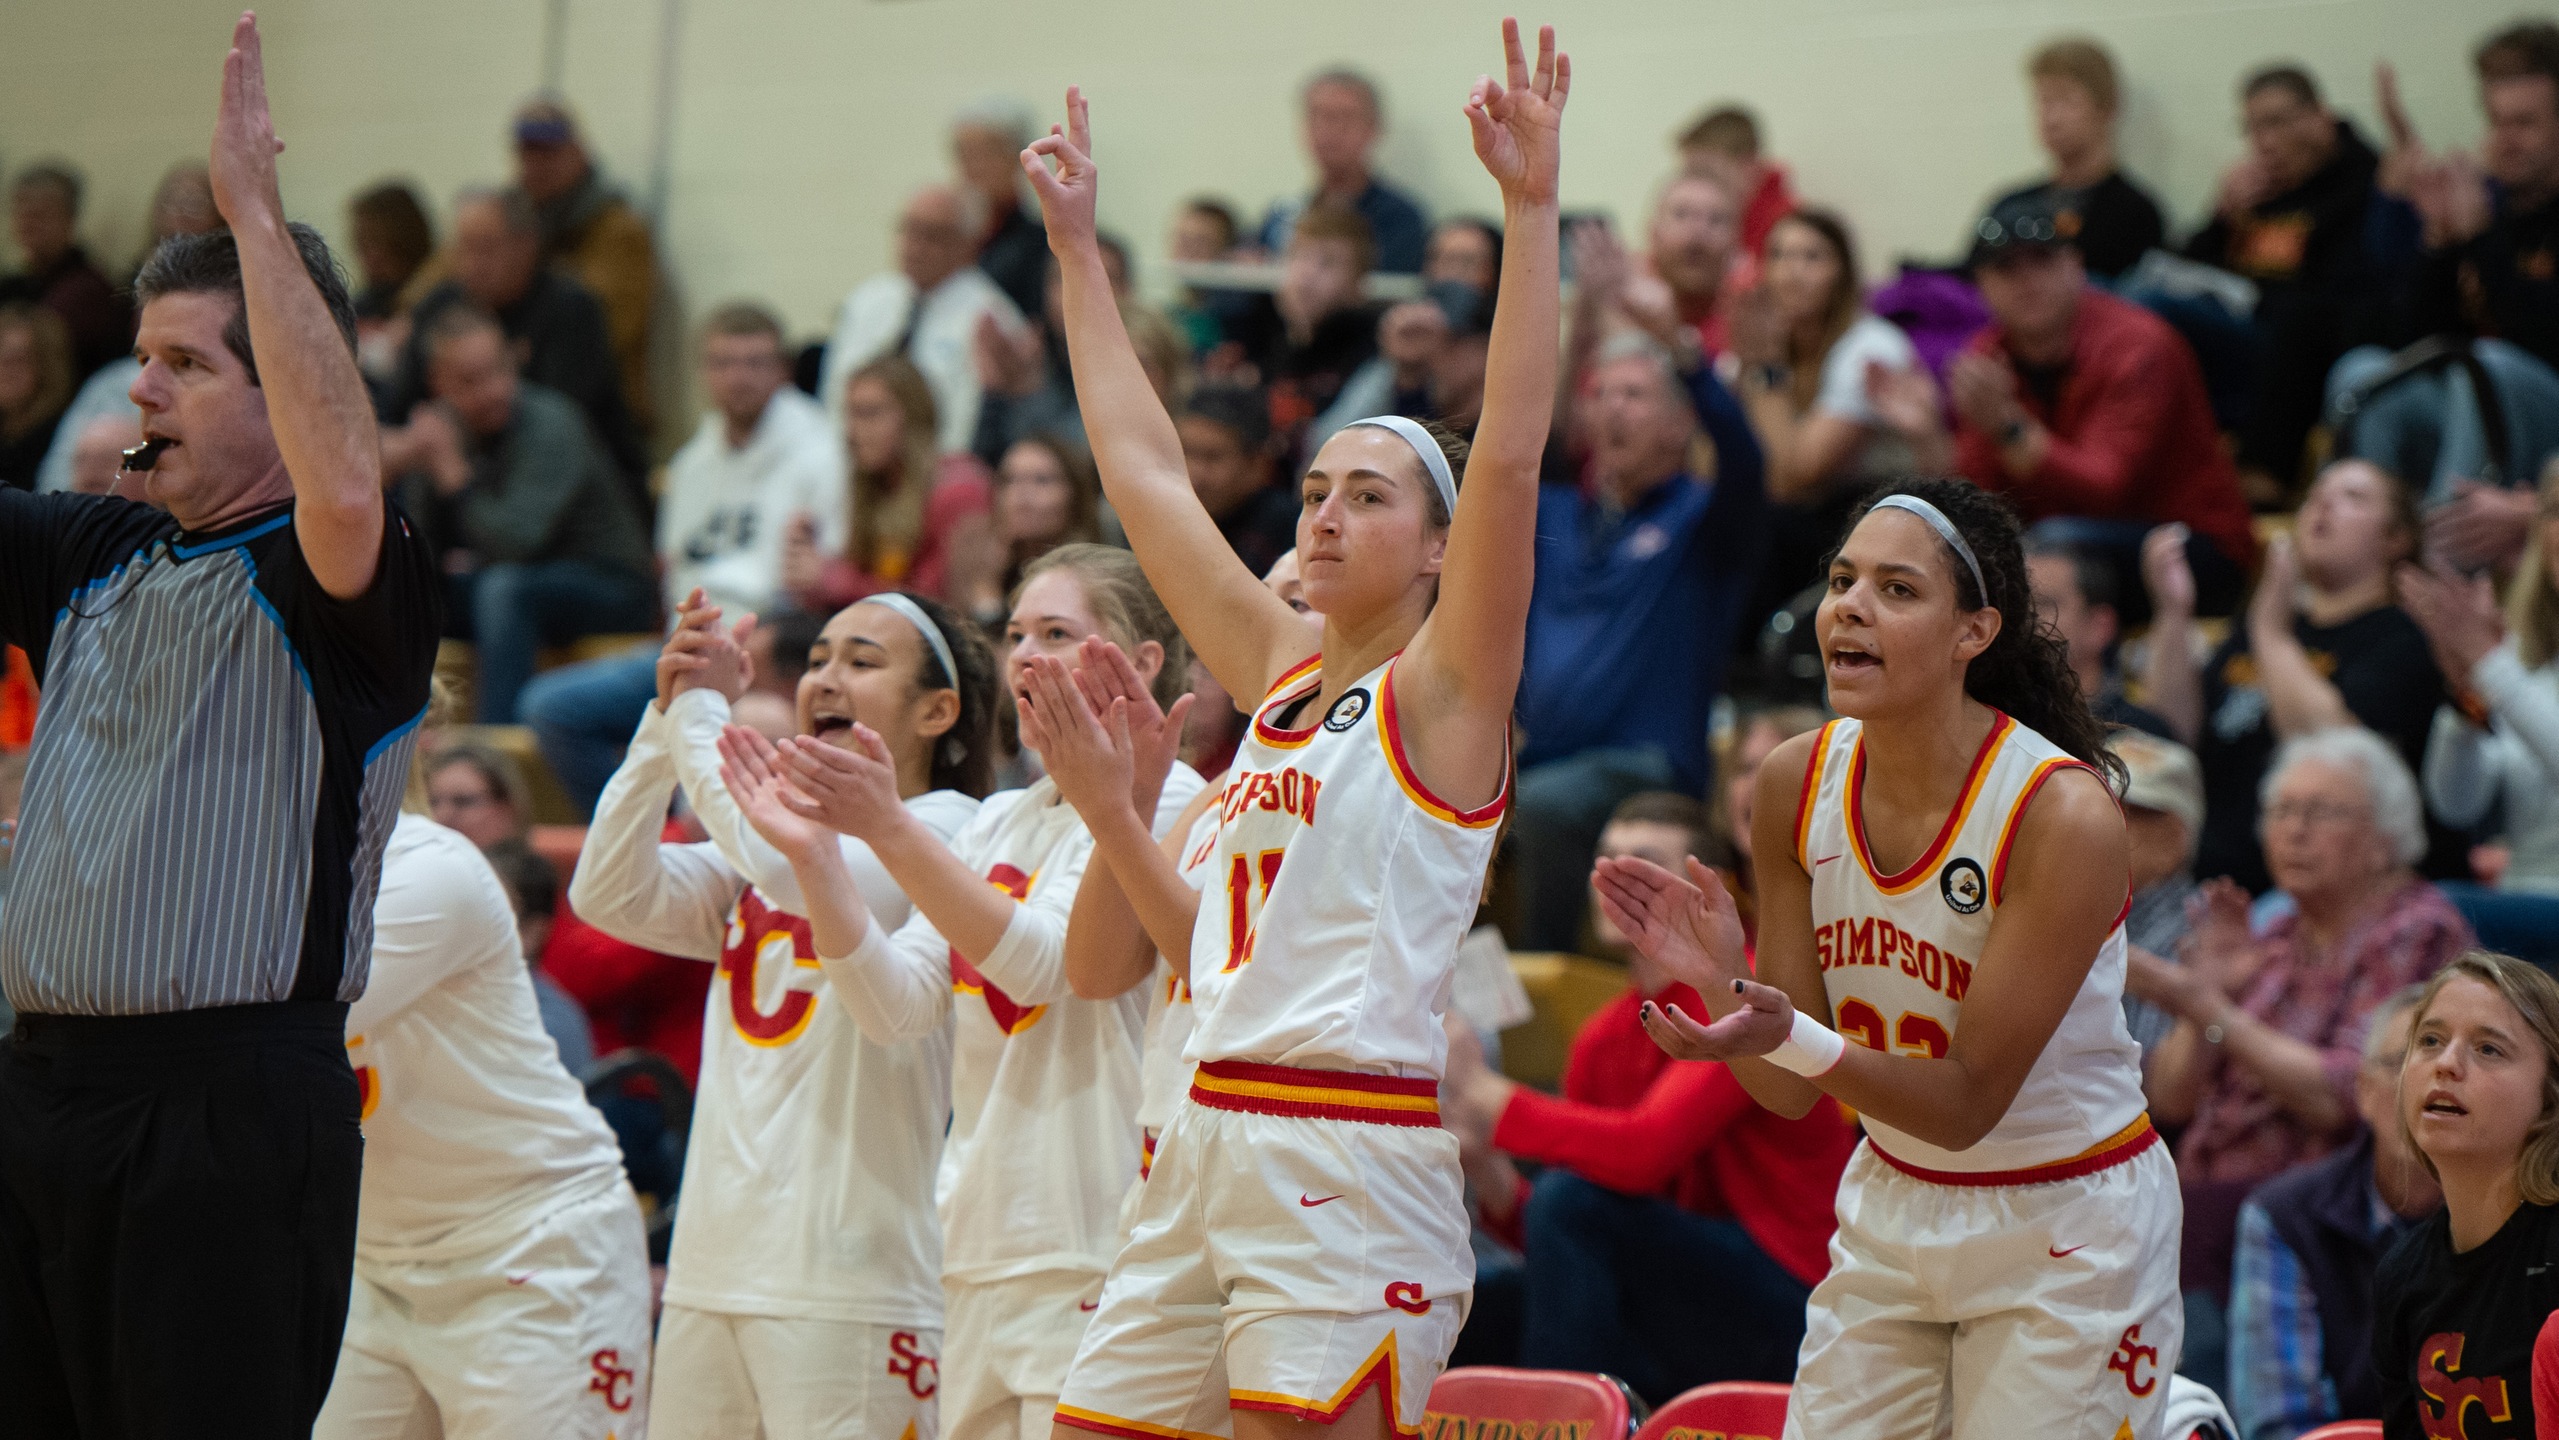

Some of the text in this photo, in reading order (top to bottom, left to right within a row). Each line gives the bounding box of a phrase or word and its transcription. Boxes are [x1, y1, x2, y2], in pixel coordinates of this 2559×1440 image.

[1945, 894, 1963, 911] United
[1815, 916, 1973, 1003] SIMPSON
[588, 1348, 634, 1415] SC
[887, 1330, 939, 1401] SC
[2107, 1324, 2158, 1399] SC
